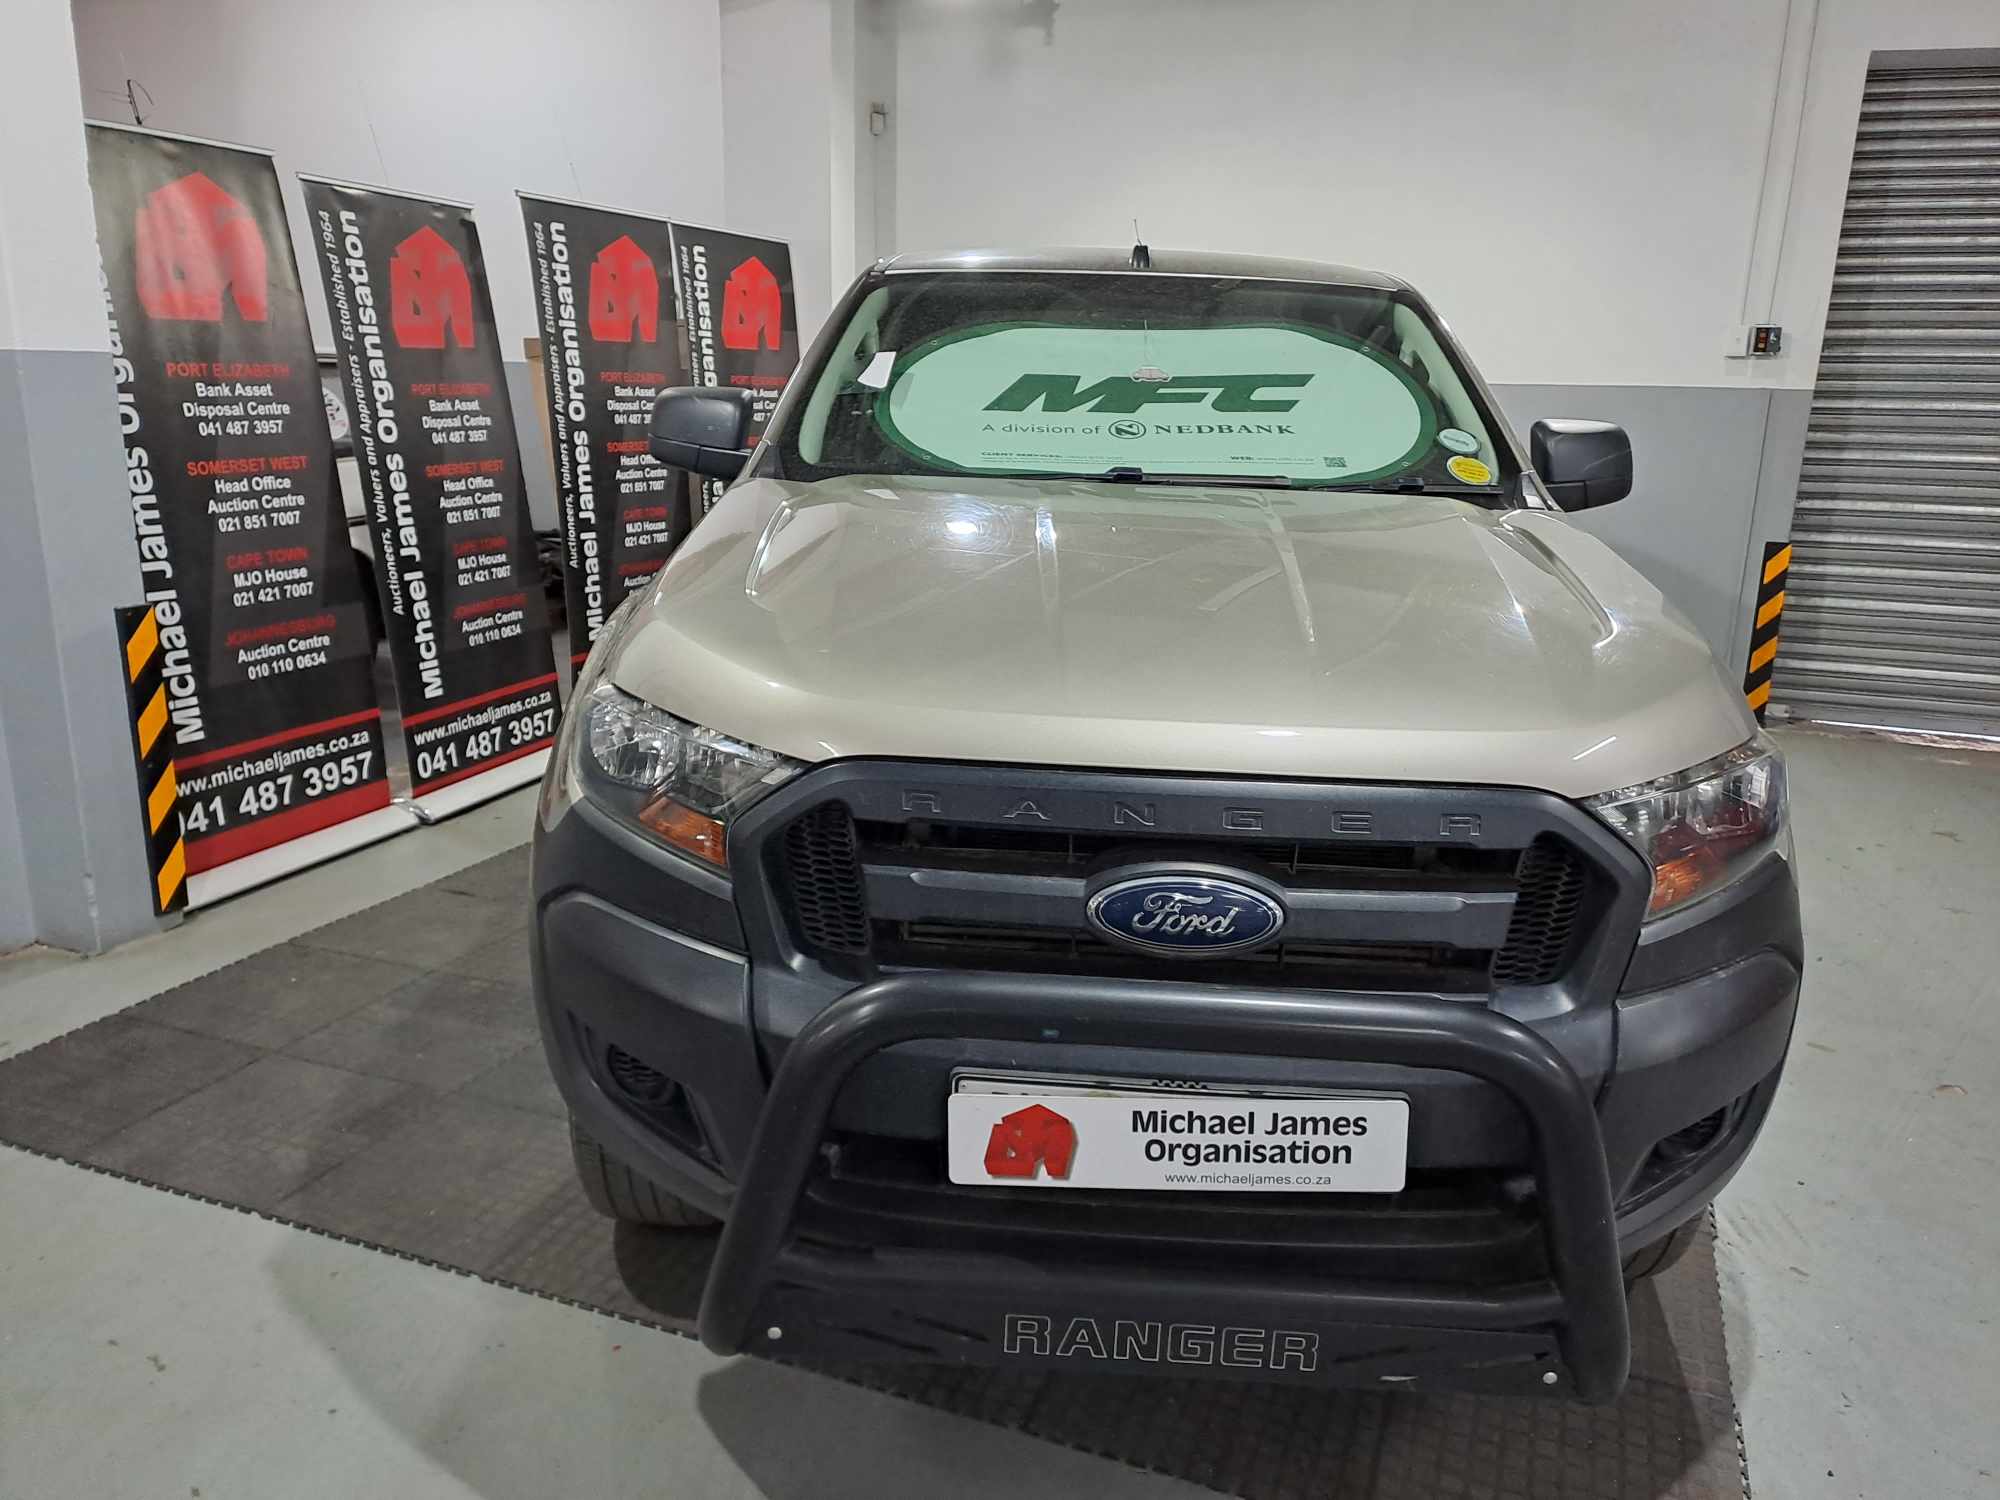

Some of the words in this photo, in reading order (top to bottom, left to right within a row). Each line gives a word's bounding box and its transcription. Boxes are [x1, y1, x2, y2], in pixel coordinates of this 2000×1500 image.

[318, 210, 337, 250] 1964
[326, 252, 355, 342] Established
[339, 210, 399, 444] Organisation
[549, 221, 586, 422] Organisation
[692, 244, 718, 387] ganisation
[165, 363, 208, 377] PORT
[195, 382, 232, 398] Bank
[234, 383, 273, 397] Asset
[348, 353, 373, 435] Appraisers
[614, 386, 634, 397] Bank
[982, 374, 1316, 414] MFC
[182, 402, 244, 420] Disposal
[247, 402, 291, 416] Centre
[428, 399, 453, 412] Bank
[454, 399, 480, 412] Asset
[606, 400, 639, 412] Disposal
[198, 421, 223, 437] 041
[225, 421, 249, 435] 487
[254, 420, 284, 435] 3957
[422, 415, 461, 430] Disposal
[463, 415, 492, 427] Centre
[555, 414, 567, 440] and
[982, 423, 995, 433] A
[1002, 421, 1075, 435] division
[1083, 423, 1102, 435] of
[1154, 424, 1296, 435] NEDBANK
[361, 436, 378, 467] and
[431, 431, 448, 445] 041
[186, 458, 266, 477] SOMERSET
[269, 456, 308, 471] WEST
[560, 442, 572, 489] Valuers
[620, 455, 639, 466] Head
[214, 478, 249, 495] Head
[251, 476, 292, 491] Office
[443, 478, 466, 492] Head
[467, 476, 494, 489] Office
[573, 430, 596, 525] James
[615, 469, 643, 480] Auction
[207, 497, 259, 515] Auction
[261, 494, 306, 509] Centre
[370, 468, 388, 524] Valuers
[385, 453, 422, 563] James
[440, 495, 473, 509] Auction
[474, 492, 503, 505] Centre
[127, 446, 173, 579] James
[218, 517, 242, 533] 021
[243, 515, 268, 530] 851
[270, 510, 301, 527] 7007
[446, 511, 462, 525] 021
[381, 528, 405, 616] Auctioneers,
[478, 553, 507, 567] House
[233, 570, 263, 588] MJO
[264, 567, 308, 583] House
[457, 571, 473, 587] 021
[474, 569, 490, 583] 421
[580, 531, 604, 642] Michael
[233, 591, 256, 608] 021
[257, 587, 281, 603] 421
[283, 581, 314, 599] 7007
[403, 570, 445, 700] Michael
[462, 616, 494, 633] Auction
[495, 610, 524, 625] Centre
[238, 643, 286, 664] Auction
[287, 635, 331, 653] Centre
[146, 590, 206, 745] Michael
[247, 665, 270, 681] 010
[271, 658, 294, 674] 110
[296, 651, 327, 670] 0634
[414, 690, 553, 746] www.michaeljames.co.za
[417, 742, 459, 779] 041
[466, 726, 503, 760] 487
[508, 709, 555, 746] 3957
[239, 774, 294, 816] 487
[302, 751, 373, 797] 3957
[901, 791, 1482, 837] RANGER
[1130, 891, 1237, 939] Ford
[1131, 1110, 1255, 1136] Michael
[1264, 1111, 1368, 1137] James
[1144, 1139, 1353, 1167] Organisation
[1164, 1173, 1332, 1187] www.michaeljames.co.za
[1003, 1313, 1320, 1372] RANGER
